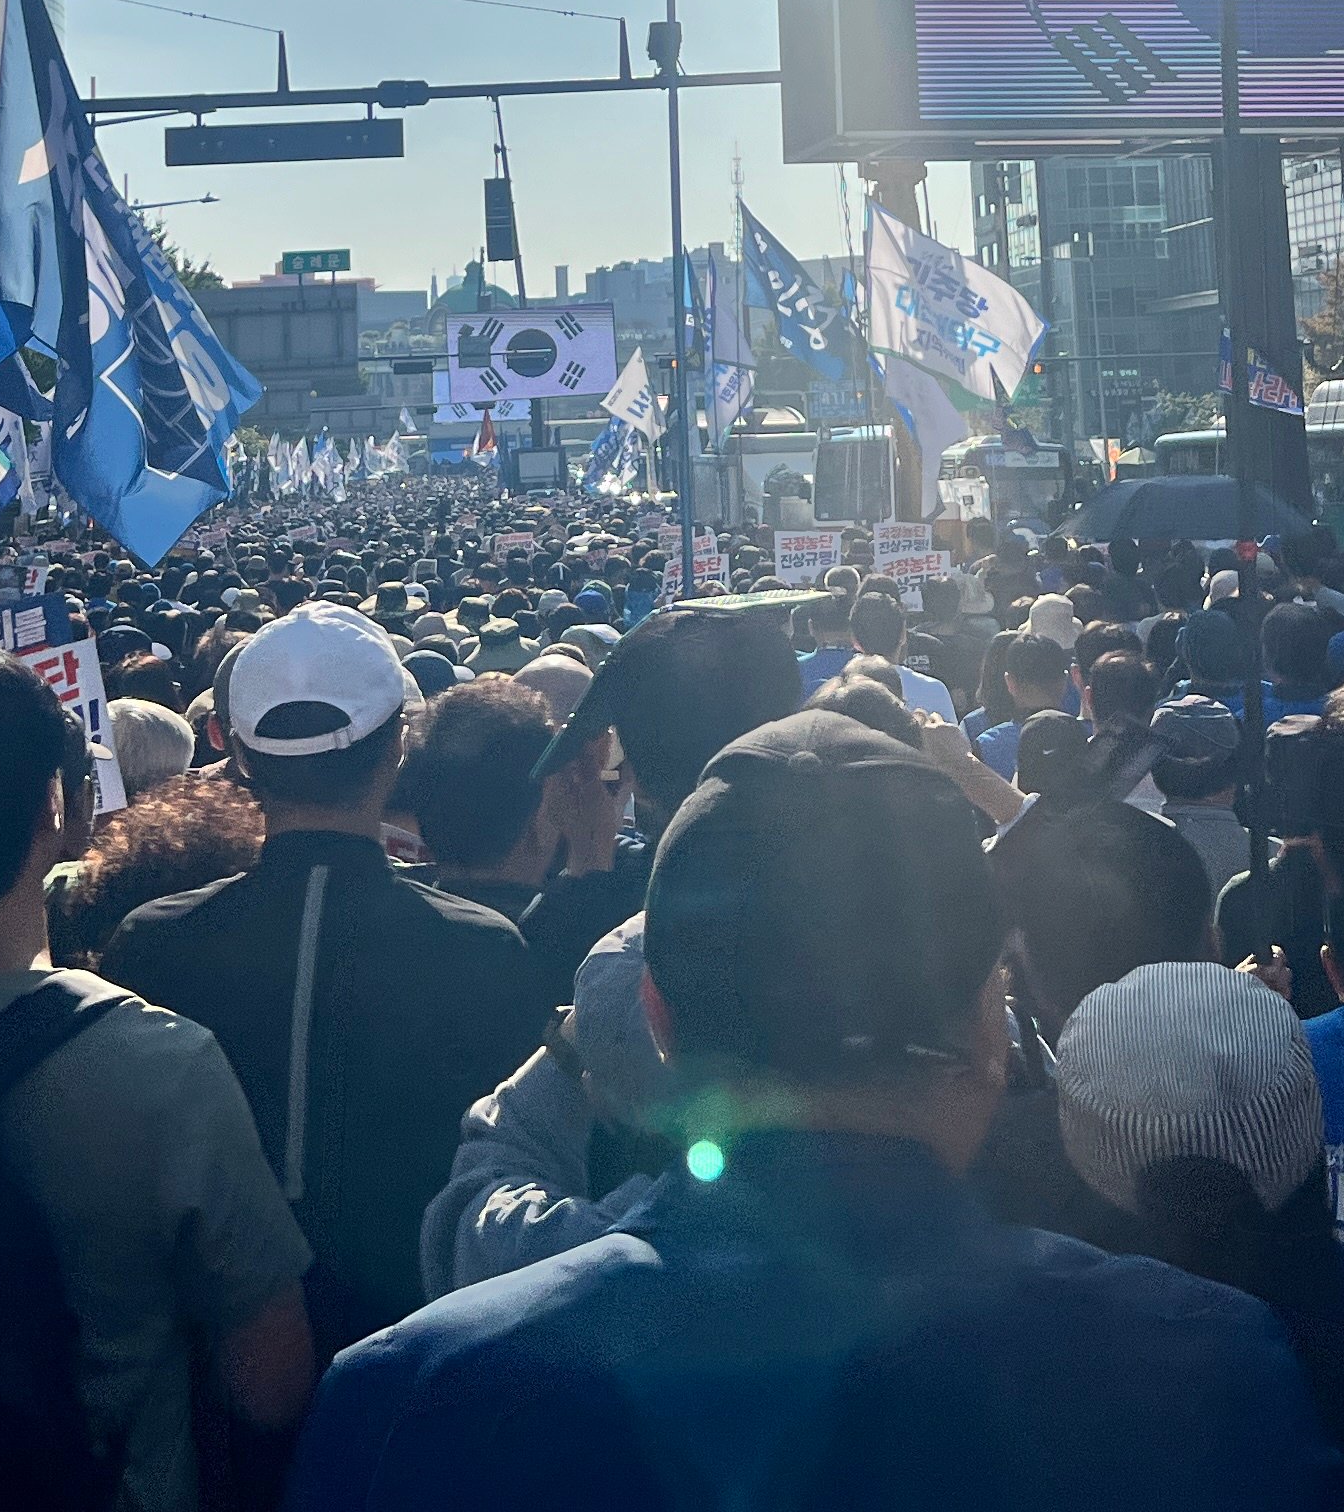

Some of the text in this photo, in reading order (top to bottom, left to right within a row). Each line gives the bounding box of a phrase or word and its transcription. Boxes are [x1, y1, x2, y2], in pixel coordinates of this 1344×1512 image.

[292, 253, 341, 270] 숭례문
[878, 524, 926, 540] 국정농단
[780, 534, 833, 552] 국정농단
[780, 549, 837, 569] 진상규명!
